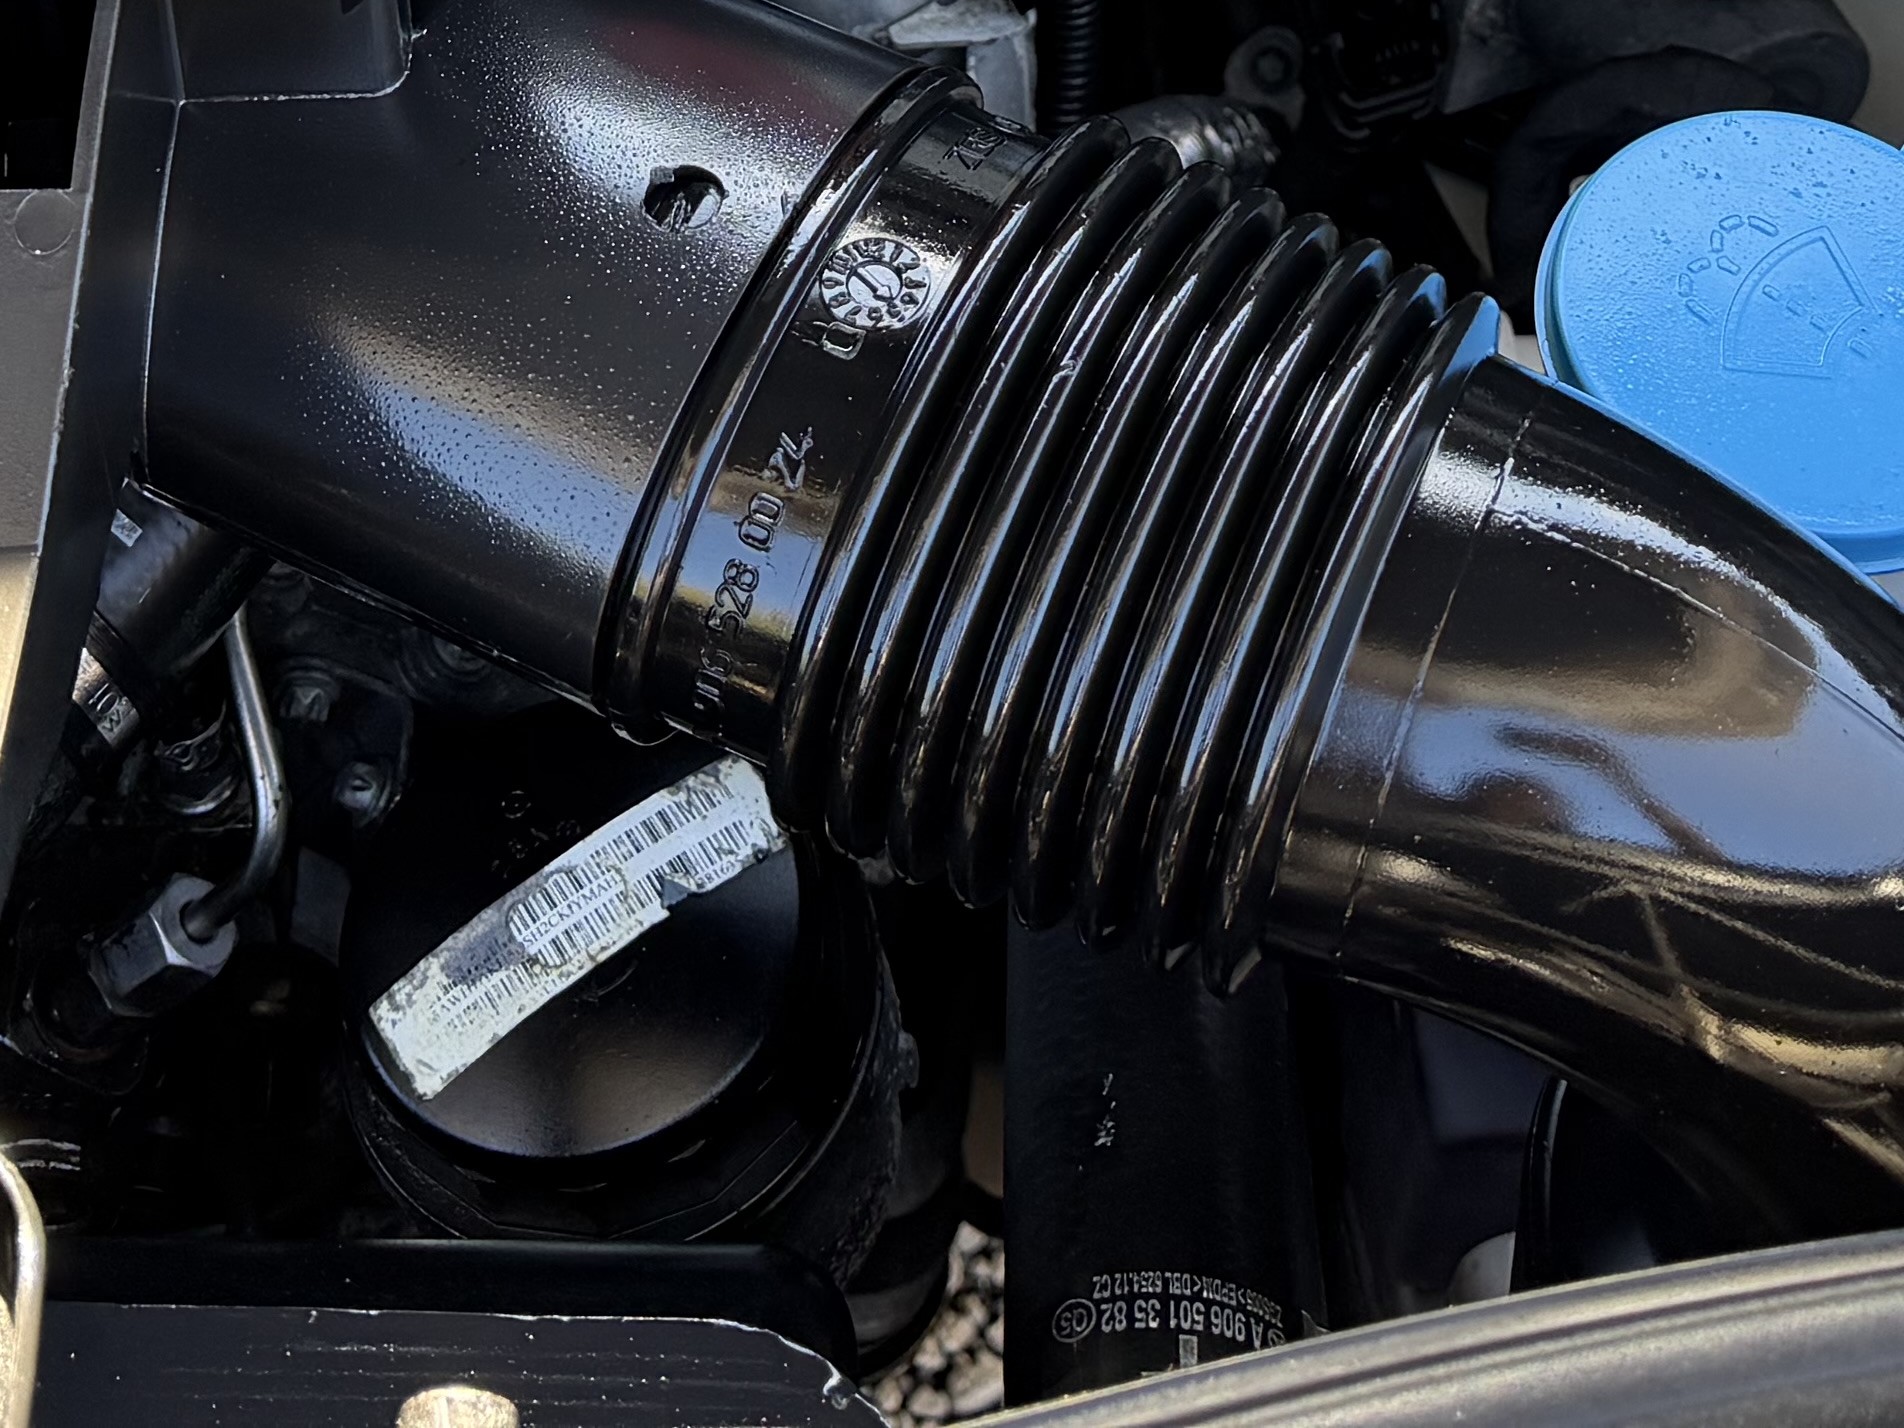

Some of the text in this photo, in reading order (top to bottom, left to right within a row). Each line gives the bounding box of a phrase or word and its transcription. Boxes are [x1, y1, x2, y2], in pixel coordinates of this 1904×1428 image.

[708, 558, 760, 636] 528
[1091, 1274, 1110, 1298] CZ
[1099, 1302, 1125, 1332] 82
[1134, 1298, 1159, 1328] 35
[1169, 1299, 1204, 1330] 501
[1210, 1304, 1245, 1341] 906
[1250, 1317, 1263, 1348] A
